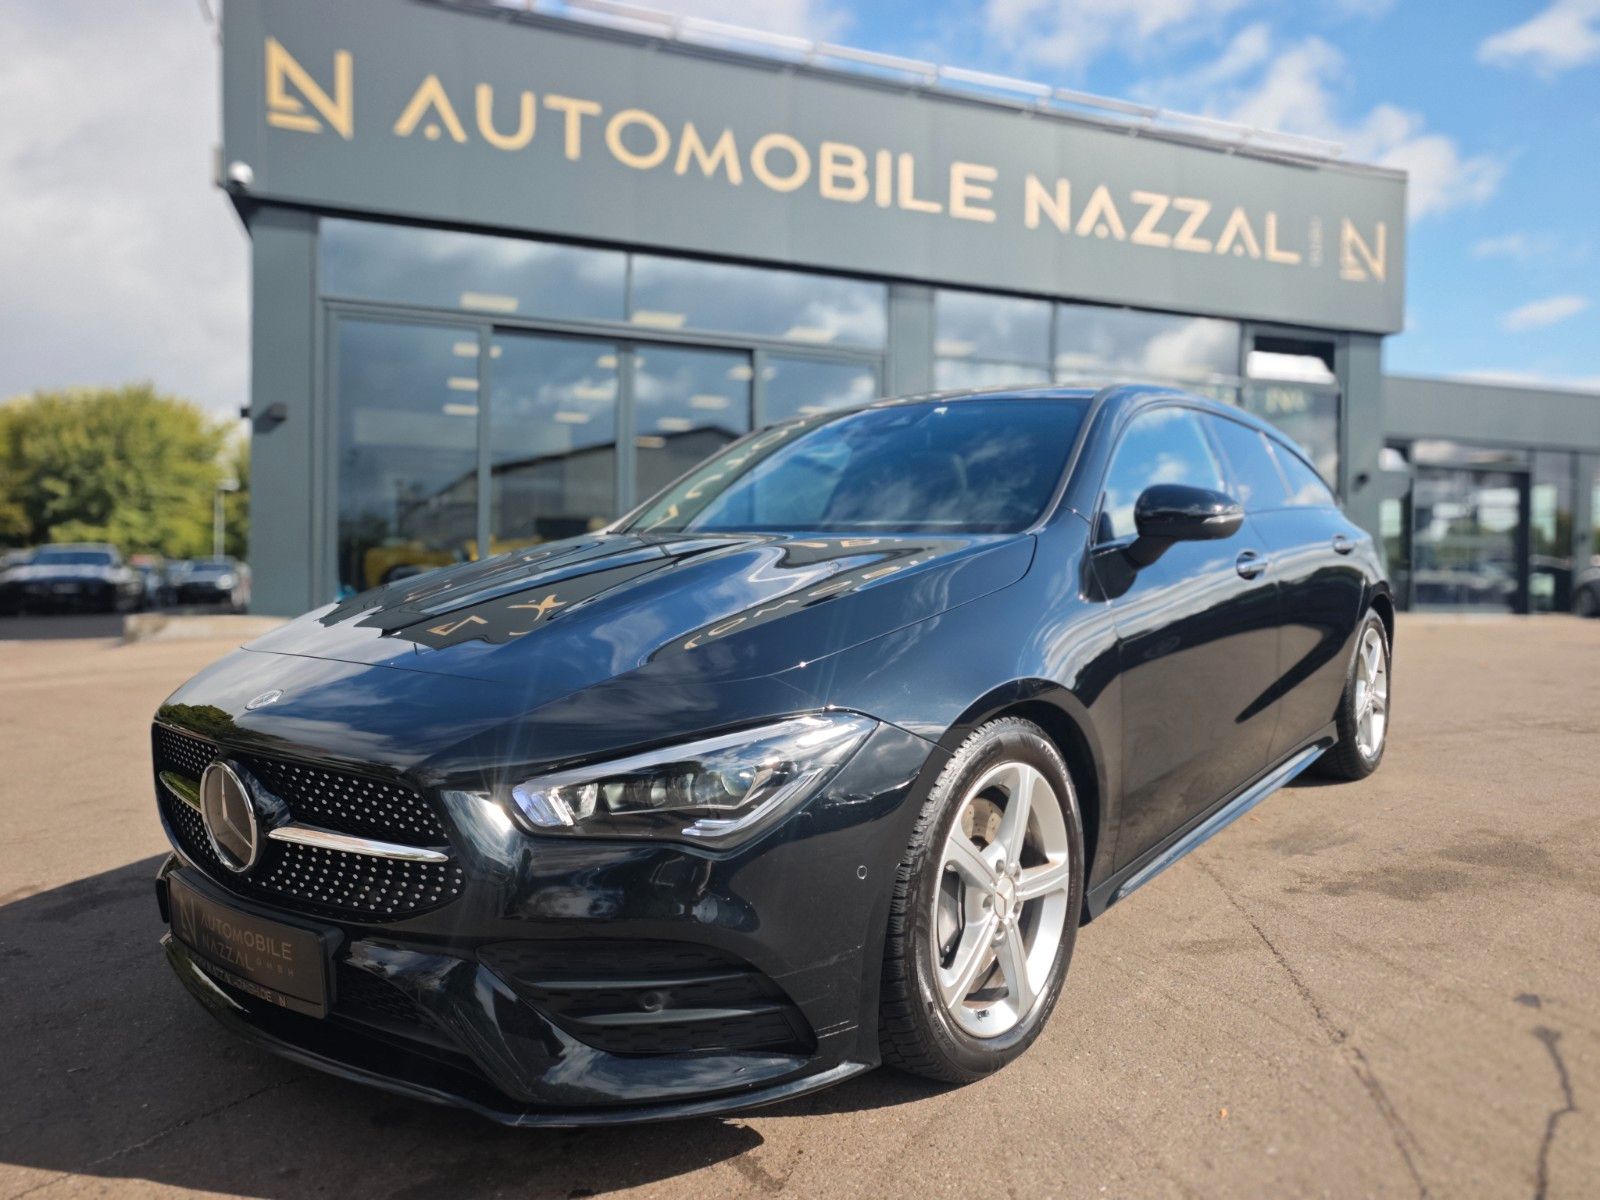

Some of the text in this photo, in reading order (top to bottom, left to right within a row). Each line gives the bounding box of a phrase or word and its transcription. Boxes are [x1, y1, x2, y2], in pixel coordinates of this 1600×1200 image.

[394, 74, 998, 223] AUTOMOBILE
[1024, 174, 1300, 265] NAZZAL
[201, 911, 293, 961] AUTOMOBILE
